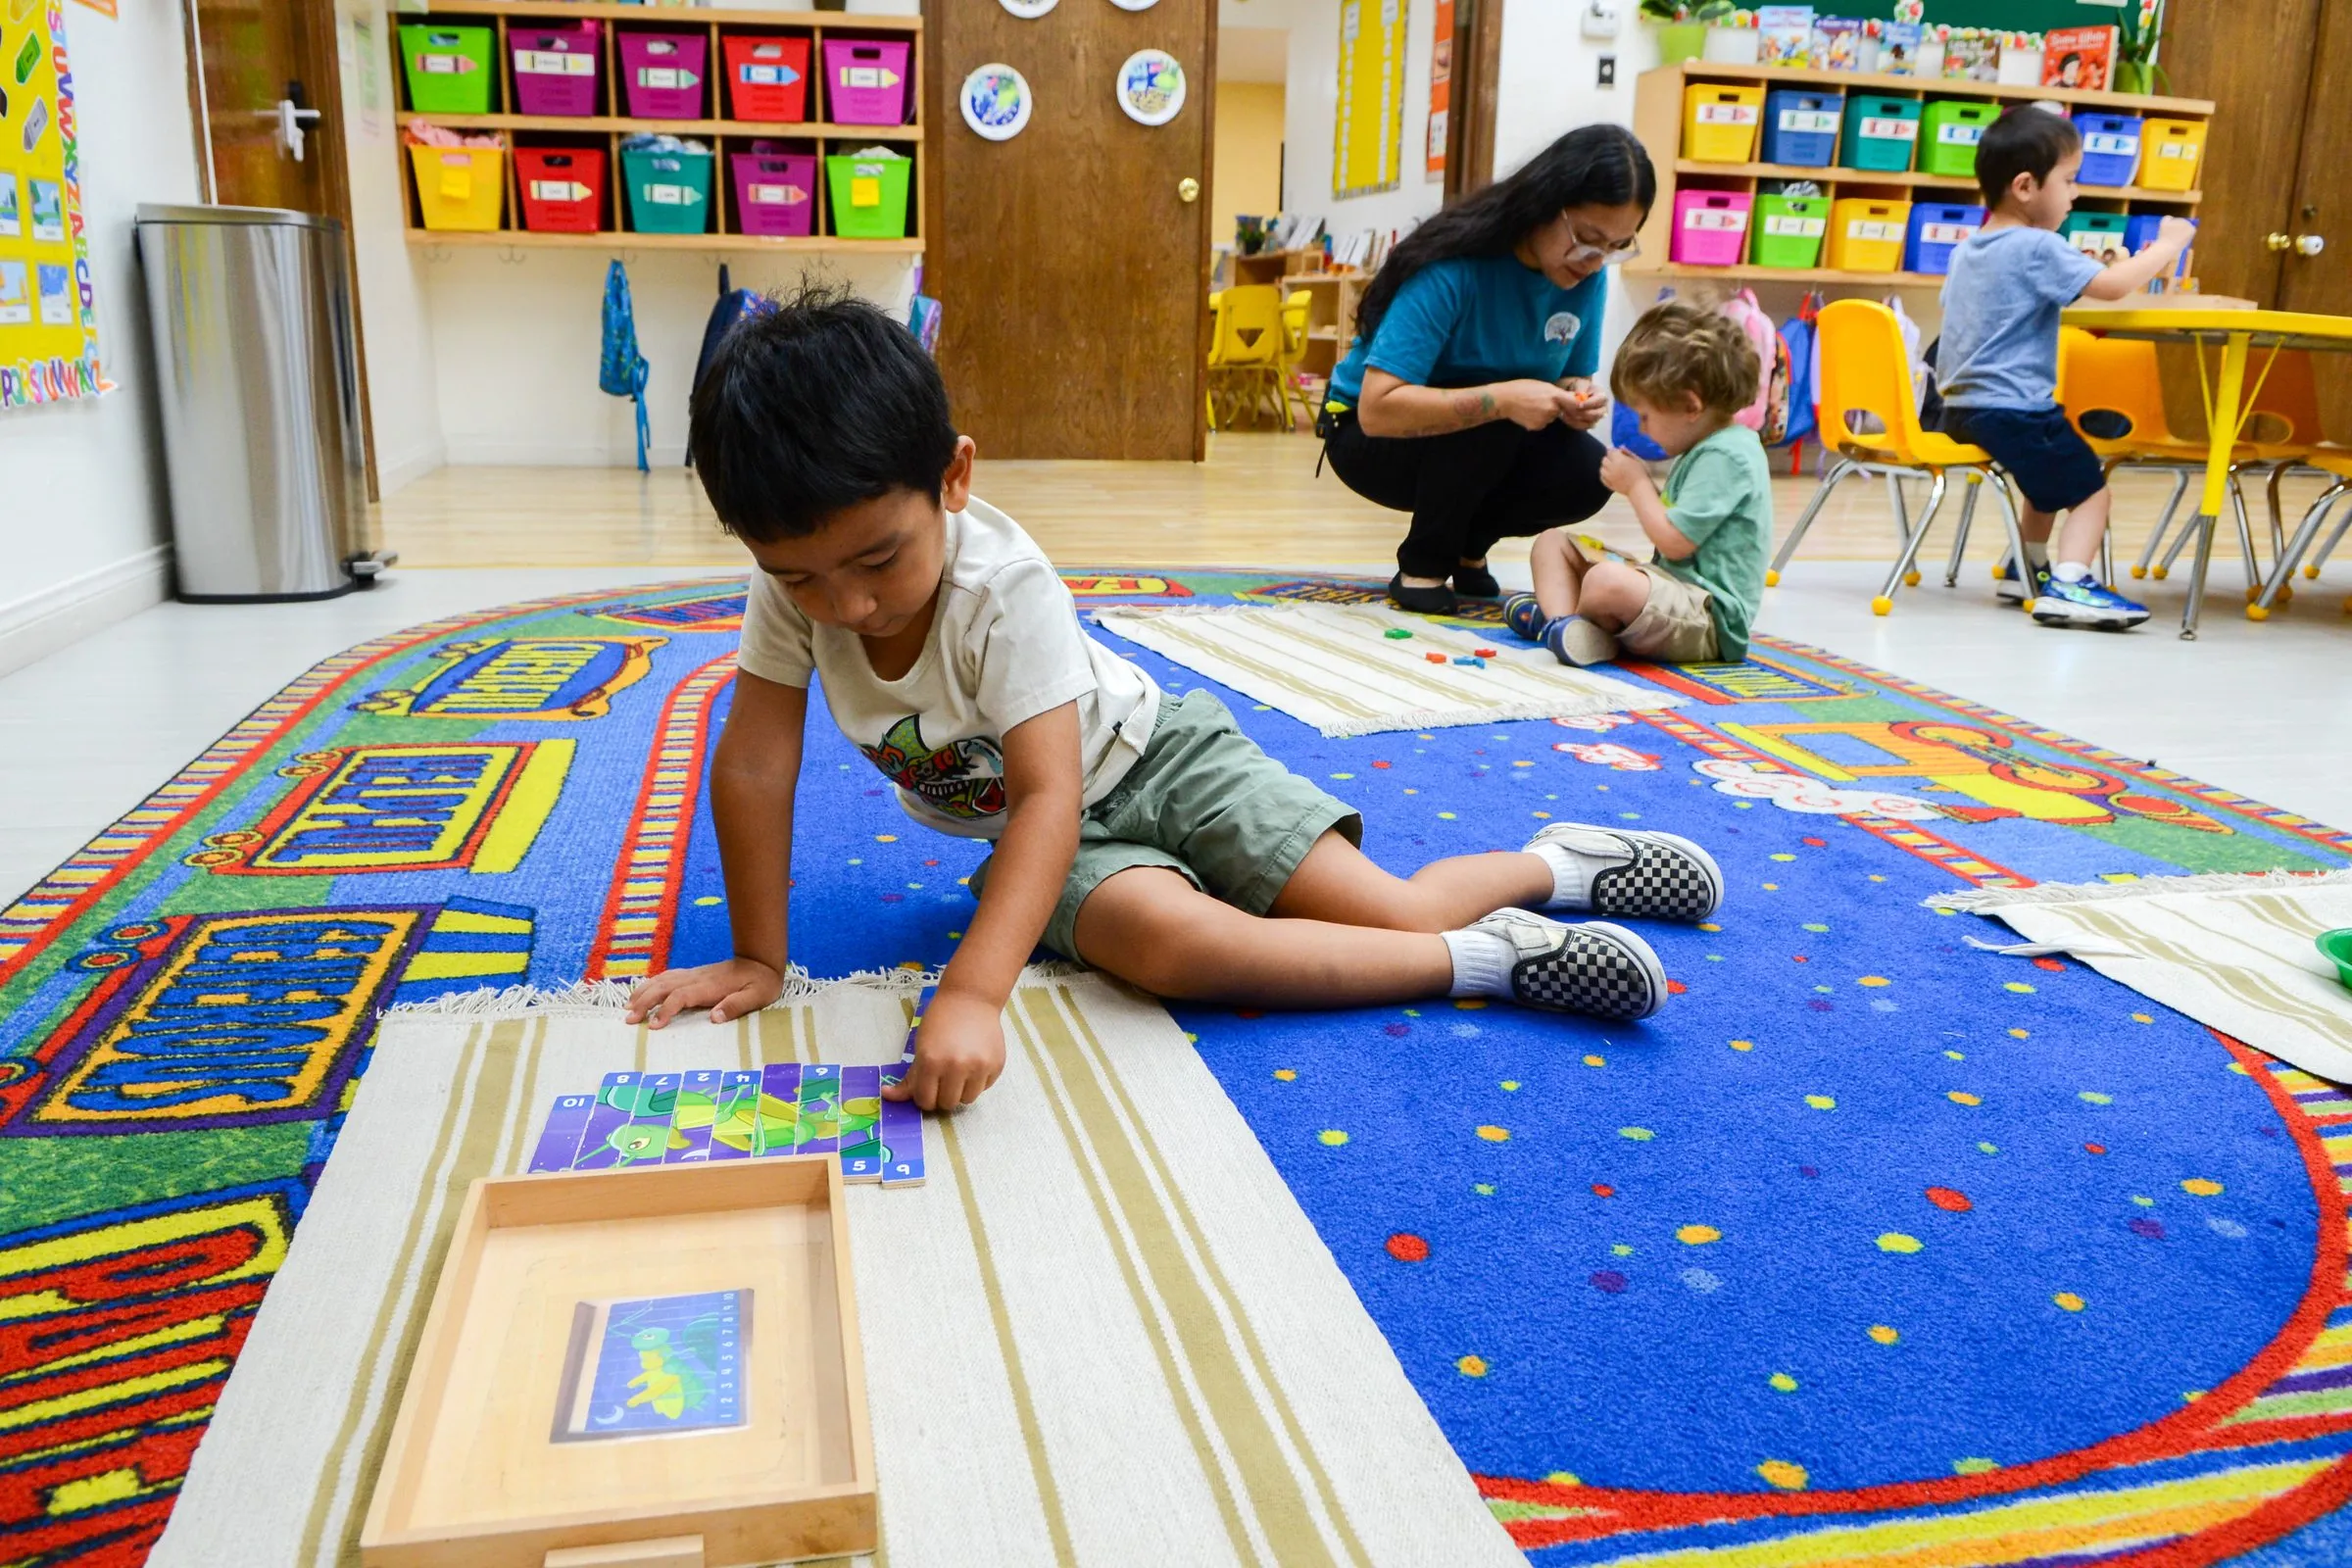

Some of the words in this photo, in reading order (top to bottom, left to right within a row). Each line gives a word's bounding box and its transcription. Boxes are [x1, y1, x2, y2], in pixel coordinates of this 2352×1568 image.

[424, 642, 606, 712] CHEERFUL
[267, 753, 494, 862] HELPFUL
[66, 919, 396, 1111] GENEROUS
[615, 1074, 630, 1084] 8
[655, 1076, 669, 1086] 7
[697, 1072, 710, 1082] 2
[735, 1074, 751, 1083] 4
[563, 1098, 585, 1108] 10
[853, 1160, 867, 1172] 5
[896, 1163, 910, 1176] 9
